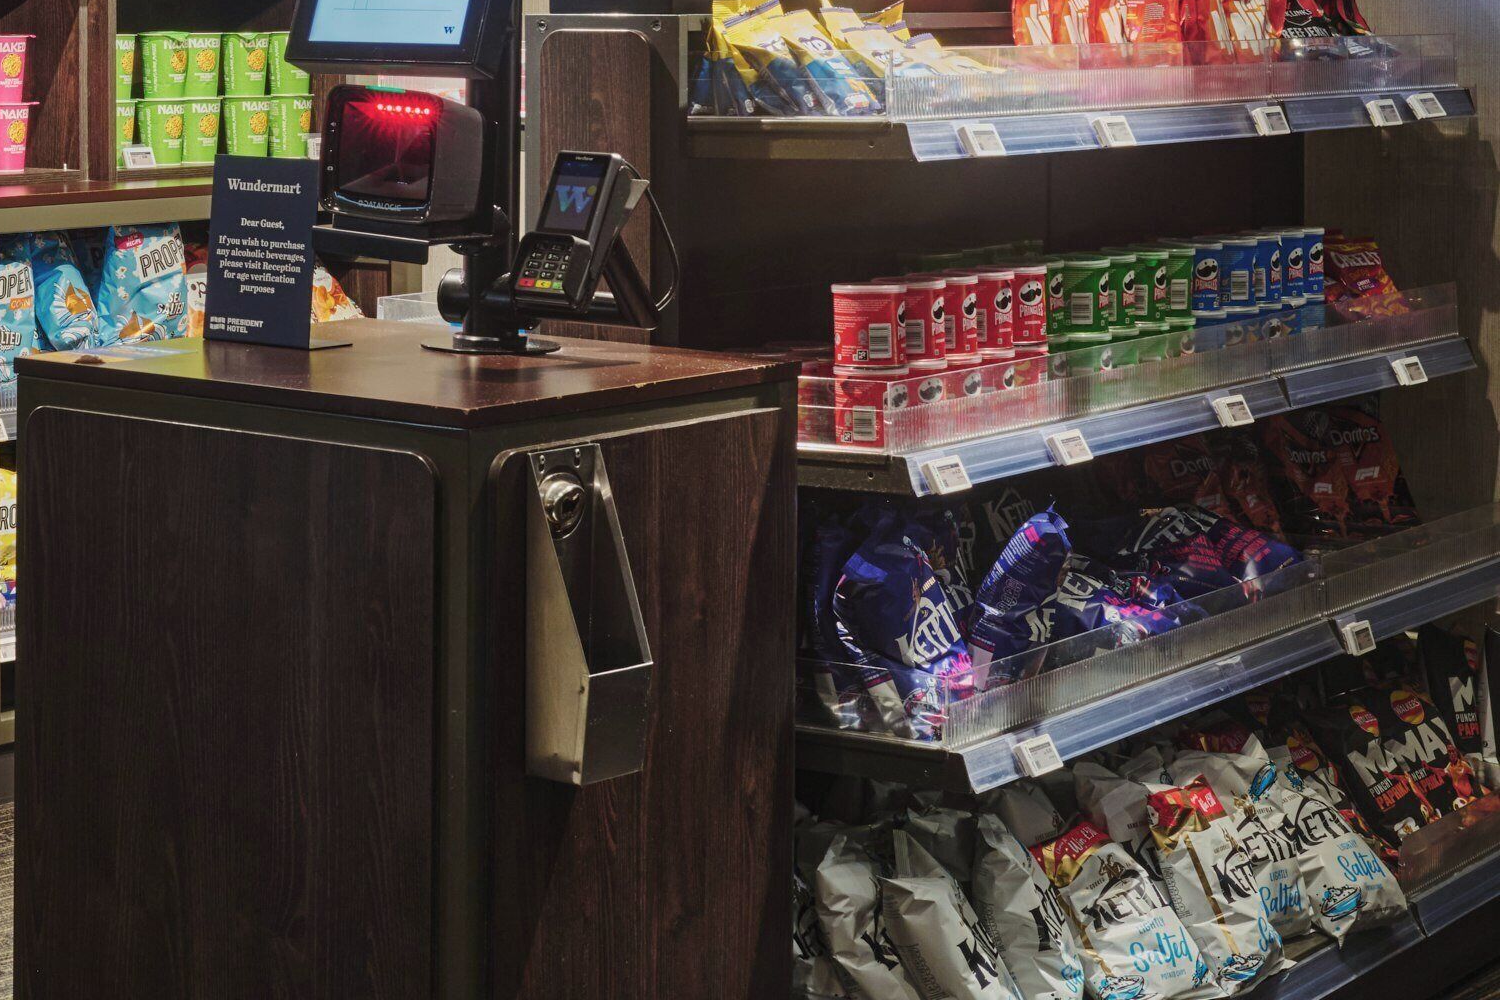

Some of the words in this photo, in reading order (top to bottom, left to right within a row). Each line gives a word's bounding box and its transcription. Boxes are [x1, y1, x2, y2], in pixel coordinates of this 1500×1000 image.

[444, 26, 455, 34] W
[116, 39, 135, 49] NAK
[293, 100, 312, 110] NAK
[228, 178, 301, 195] Wundermart
[556, 185, 592, 213] W
[241, 218, 259, 228] Dear
[260, 219, 285, 231] Guest,
[219, 235, 226, 244] If
[226, 238, 241, 247] you
[241, 236, 259, 247] wish
[261, 238, 268, 247] to
[269, 240, 306, 251] purchase
[216, 249, 230, 257] any
[231, 248, 265, 259] alcoholic
[266, 251, 306, 264] beverages,
[219, 259, 243, 270] please
[244, 260, 261, 270] visit
[263, 262, 301, 274] Reception
[224, 270, 236, 279] for
[236, 272, 250, 281] age
[250, 272, 296, 285] verification
[240, 284, 275, 294] purposes
[1019, 303, 1044, 318] PRINGLES
[226, 325, 248, 334] HOTEL
[227, 317, 264, 328] PRESIDENT
[1329, 424, 1380, 447] Doritos
[1394, 698, 1420, 716] WALKERS
[1411, 768, 1428, 781] NCHY
[1369, 777, 1393, 798] PUNCHY
[1337, 851, 1386, 883] Salted
[1269, 868, 1289, 883] LIGHTLY
[1138, 915, 1166, 935] LIGHTLY
[1129, 926, 1193, 974] Salted
